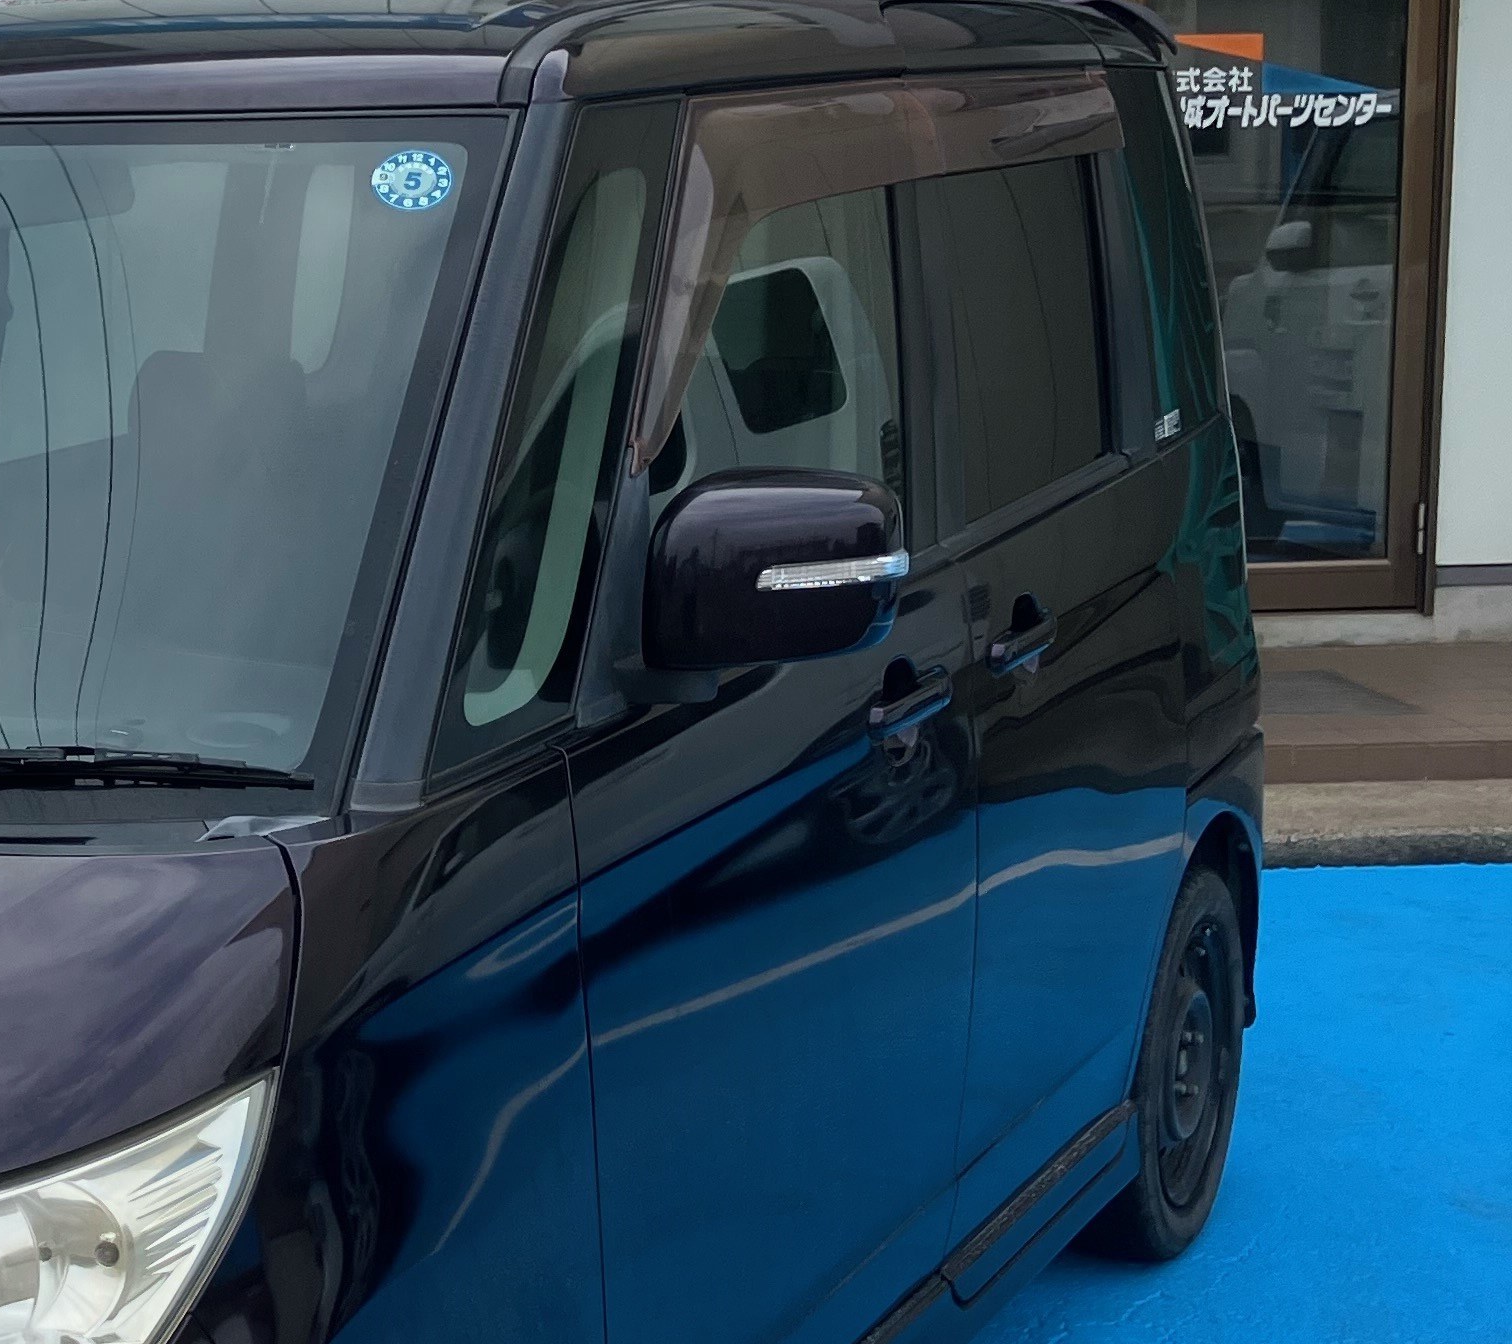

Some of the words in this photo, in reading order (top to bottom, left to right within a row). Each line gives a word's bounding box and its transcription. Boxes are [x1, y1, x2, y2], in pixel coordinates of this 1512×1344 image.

[1173, 66, 1254, 93] 式会社
[1180, 93, 1393, 129] 城オートパーツセンター
[411, 153, 424, 162] 12
[404, 171, 422, 190] 5
